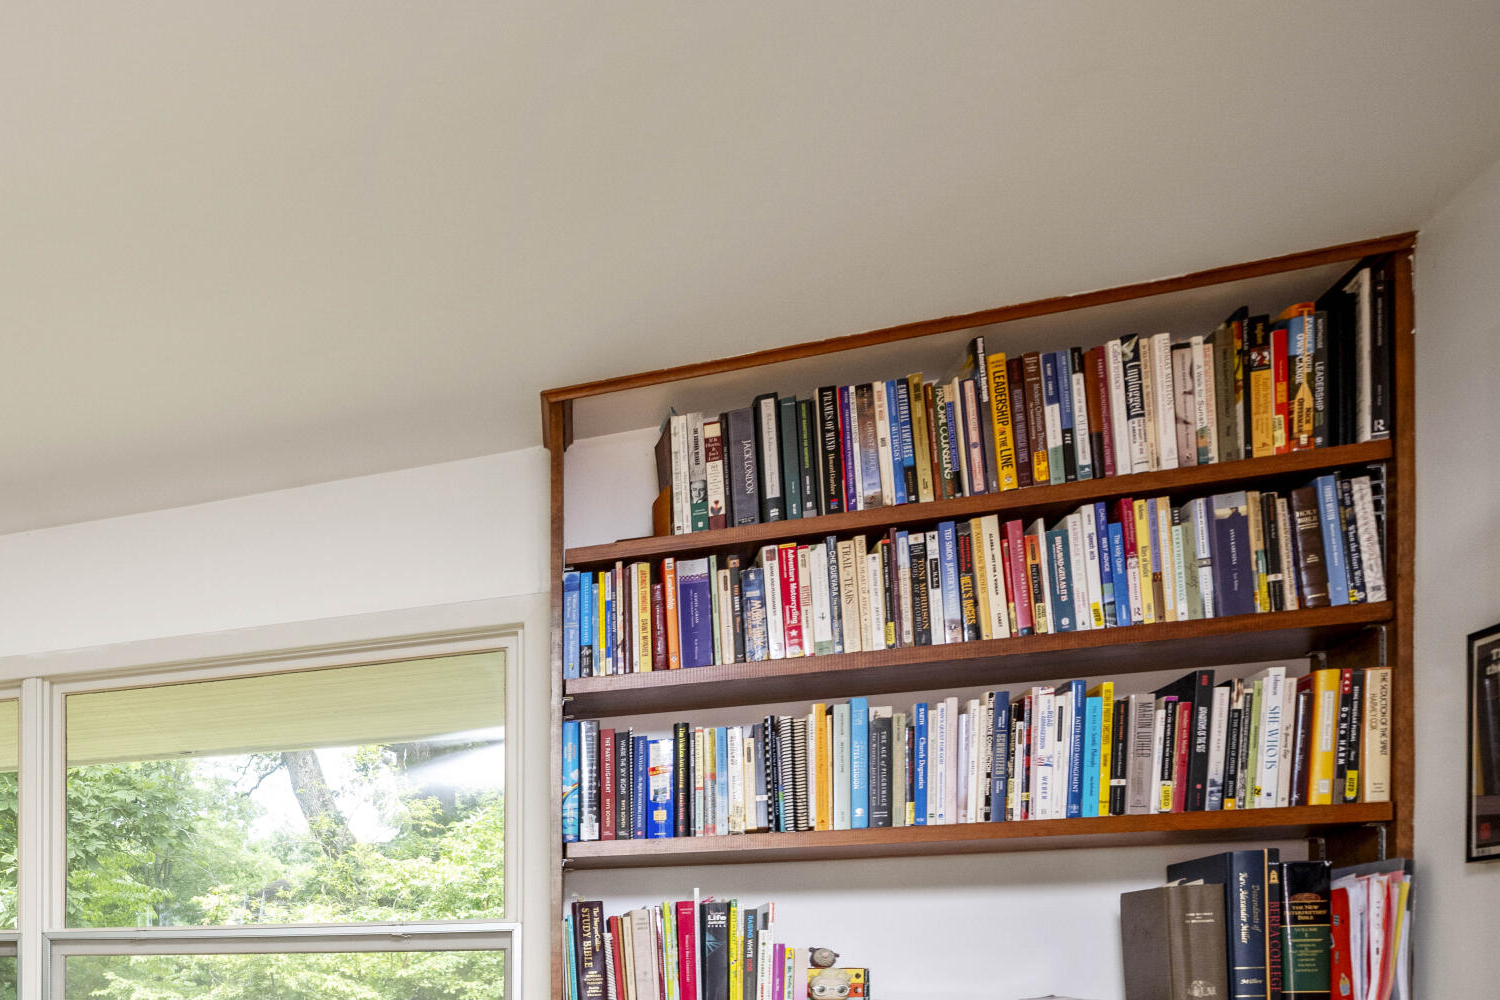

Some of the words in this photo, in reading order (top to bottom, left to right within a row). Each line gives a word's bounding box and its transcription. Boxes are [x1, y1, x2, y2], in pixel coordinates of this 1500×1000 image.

[1163, 337, 1172, 371] THOMAS
[992, 370, 1009, 426] LEADERSHIP
[1126, 361, 1144, 415] Unplugged
[1164, 373, 1174, 406] MERTON
[1315, 361, 1324, 411] LEADERSHIP
[823, 391, 835, 420] FRAMES
[897, 384, 909, 423] EMOTIONAL
[935, 388, 949, 425] PASTORAL
[1297, 398, 1305, 433] OFFERMAN
[1305, 407, 1313, 424] NICK
[825, 421, 835, 431] OF
[742, 440, 752, 459] JACK
[826, 432, 836, 451] MIND
[901, 425, 913, 458] VAMPIRES
[939, 426, 954, 479] COUNSELING
[1000, 437, 1010, 448] THE
[1000, 448, 1013, 470] LINE
[744, 460, 754, 494] LONDON
[1088, 532, 1096, 549] Speech
[1101, 537, 1109, 552] BEST
[1348, 525, 1357, 540] When
[841, 544, 852, 571] TRAIL
[1055, 536, 1066, 580] BHAGAVAD-GITA
[1114, 545, 1122, 557] Holy
[1350, 542, 1358, 551] the
[787, 549, 795, 581] Adventure
[1351, 553, 1361, 571] Heart
[844, 577, 853, 605] TEARS
[960, 576, 972, 598] HELL'S
[1019, 573, 1028, 607] MARGARITA
[1031, 564, 1039, 594] INFERNO
[1354, 572, 1362, 586] Waits
[789, 583, 798, 624] Motorcycling
[919, 583, 930, 629] MORRISON
[963, 600, 976, 624] ANGELS
[1380, 672, 1388, 684] THE
[1380, 684, 1388, 713] SEDUCTION
[1137, 702, 1153, 728] MARTIN
[1267, 705, 1281, 726] SHE
[1340, 707, 1349, 719] Do
[1380, 713, 1388, 726] OF
[1265, 727, 1279, 757] WHO
[1340, 723, 1348, 735] No
[1380, 727, 1388, 739] THE
[995, 733, 1005, 775] SCHWEITZER
[1135, 731, 1152, 758] LUTHER
[1337, 740, 1347, 765] HARM
[1380, 740, 1388, 756] SPIRIT
[1072, 753, 1080, 793] MANAGEMENT
[1265, 760, 1278, 770] IS
[1347, 777, 1355, 792] USED
[1163, 790, 1171, 807] USED
[1239, 872, 1248, 888] Rev.
[1239, 889, 1249, 922] Alexander
[1251, 884, 1260, 923] Descendants
[581, 907, 592, 939] STUDY
[1252, 924, 1262, 933] of
[1268, 901, 1280, 937] BEREA
[593, 918, 601, 952] HarperCollins
[1240, 924, 1249, 944] Miller
[583, 940, 593, 968] BIBLE
[1269, 939, 1281, 992] COLLEGE
